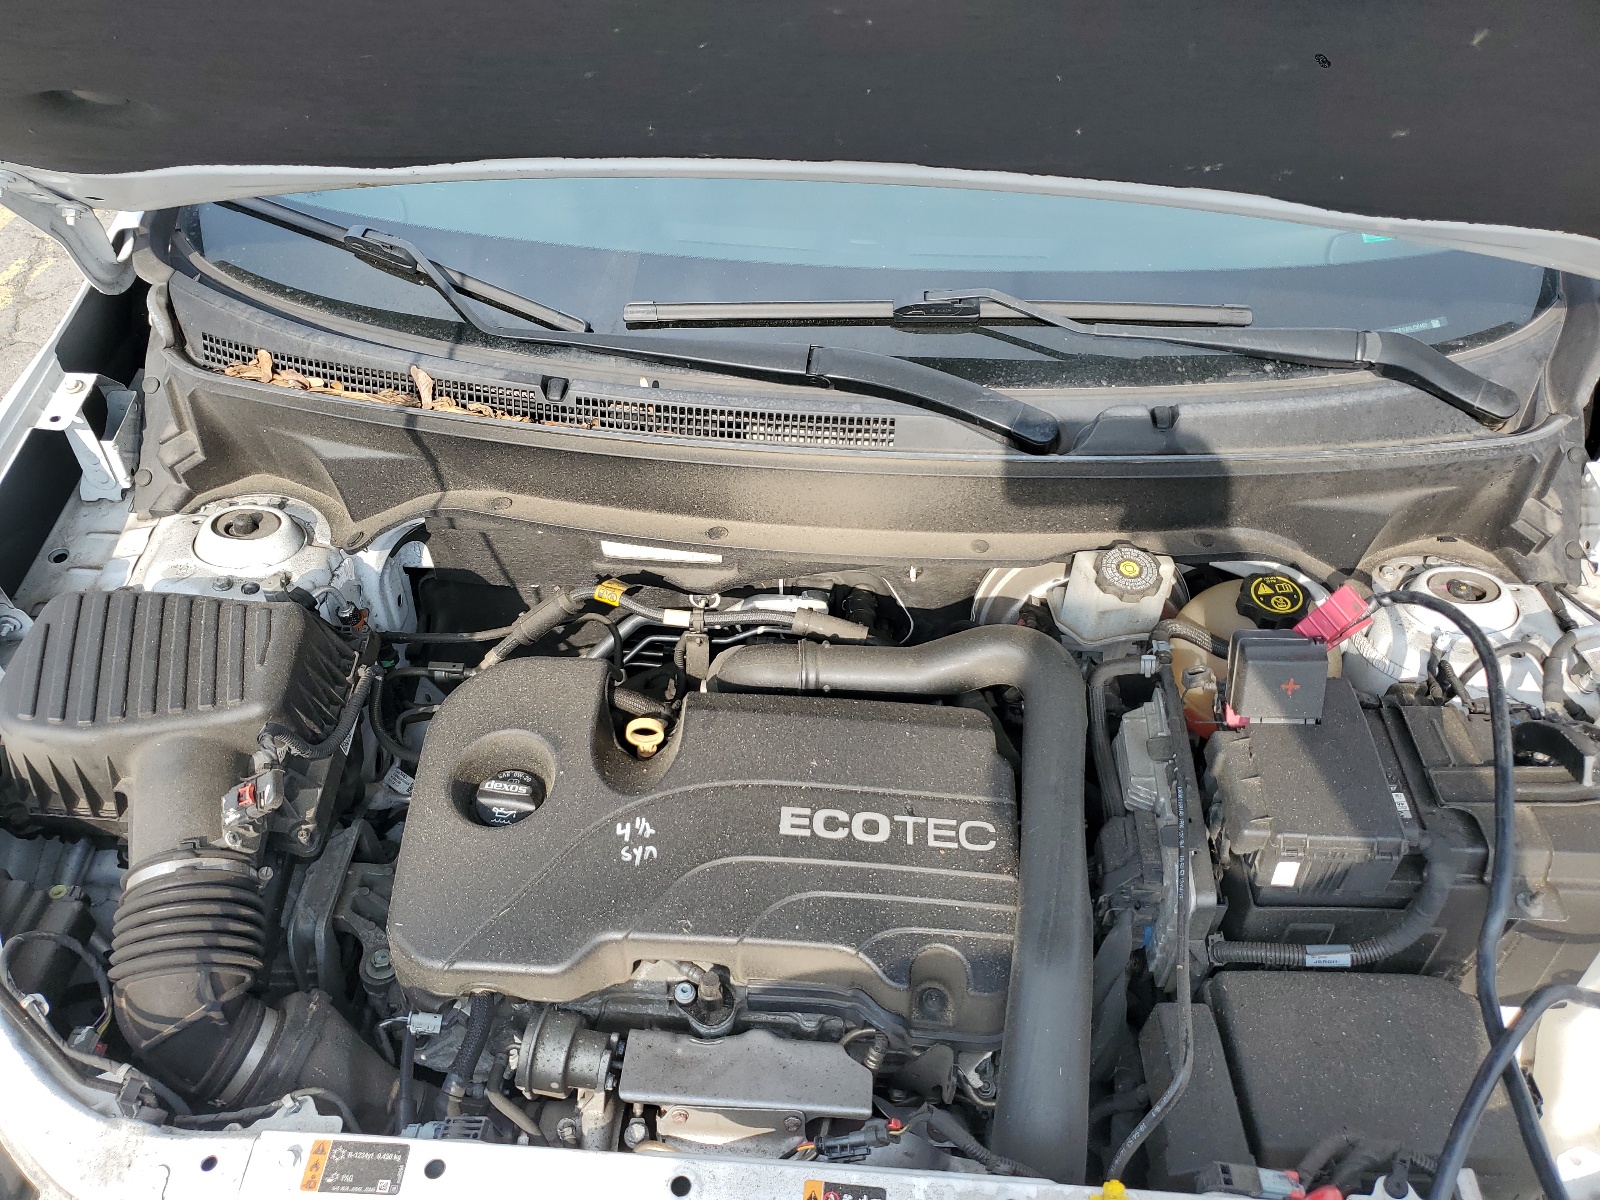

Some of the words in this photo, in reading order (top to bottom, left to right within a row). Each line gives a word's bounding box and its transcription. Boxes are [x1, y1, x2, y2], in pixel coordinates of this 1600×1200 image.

[485, 780, 528, 793] dexos
[779, 806, 997, 851] ECOTEC
[620, 845, 658, 867] syn
